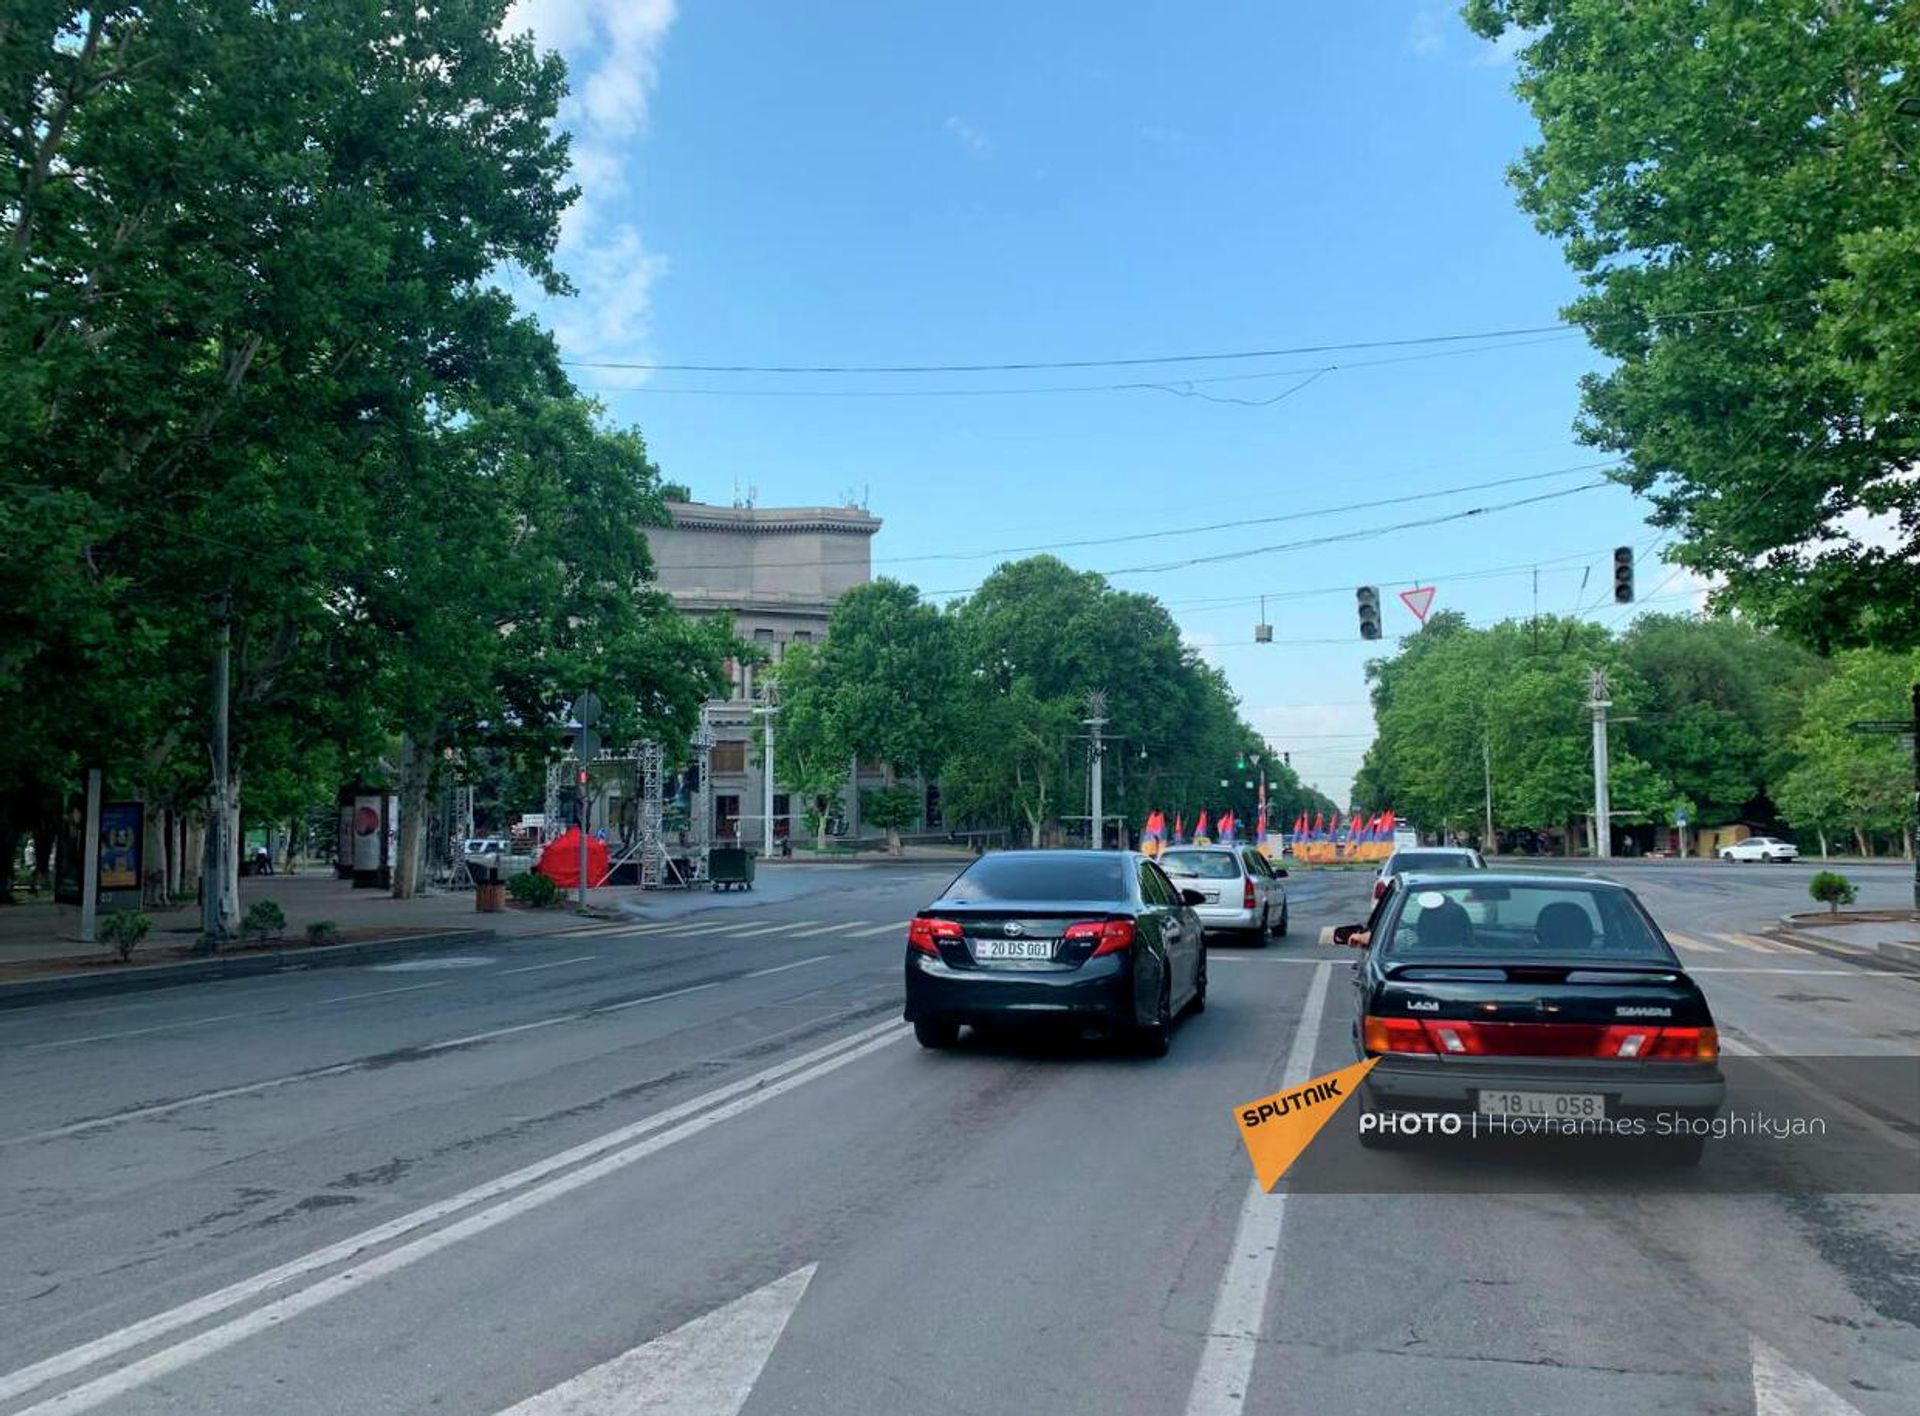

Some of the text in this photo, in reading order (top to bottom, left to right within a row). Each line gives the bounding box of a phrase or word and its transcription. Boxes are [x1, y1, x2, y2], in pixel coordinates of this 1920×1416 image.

[991, 942, 1005, 955] 20
[1008, 942, 1024, 955] DS
[1027, 943, 1048, 956] 001
[1407, 1001, 1439, 1011] LADA
[1500, 1095, 1522, 1113] 18
[1529, 1100, 1546, 1113] LL
[1556, 1097, 1594, 1115] 058
